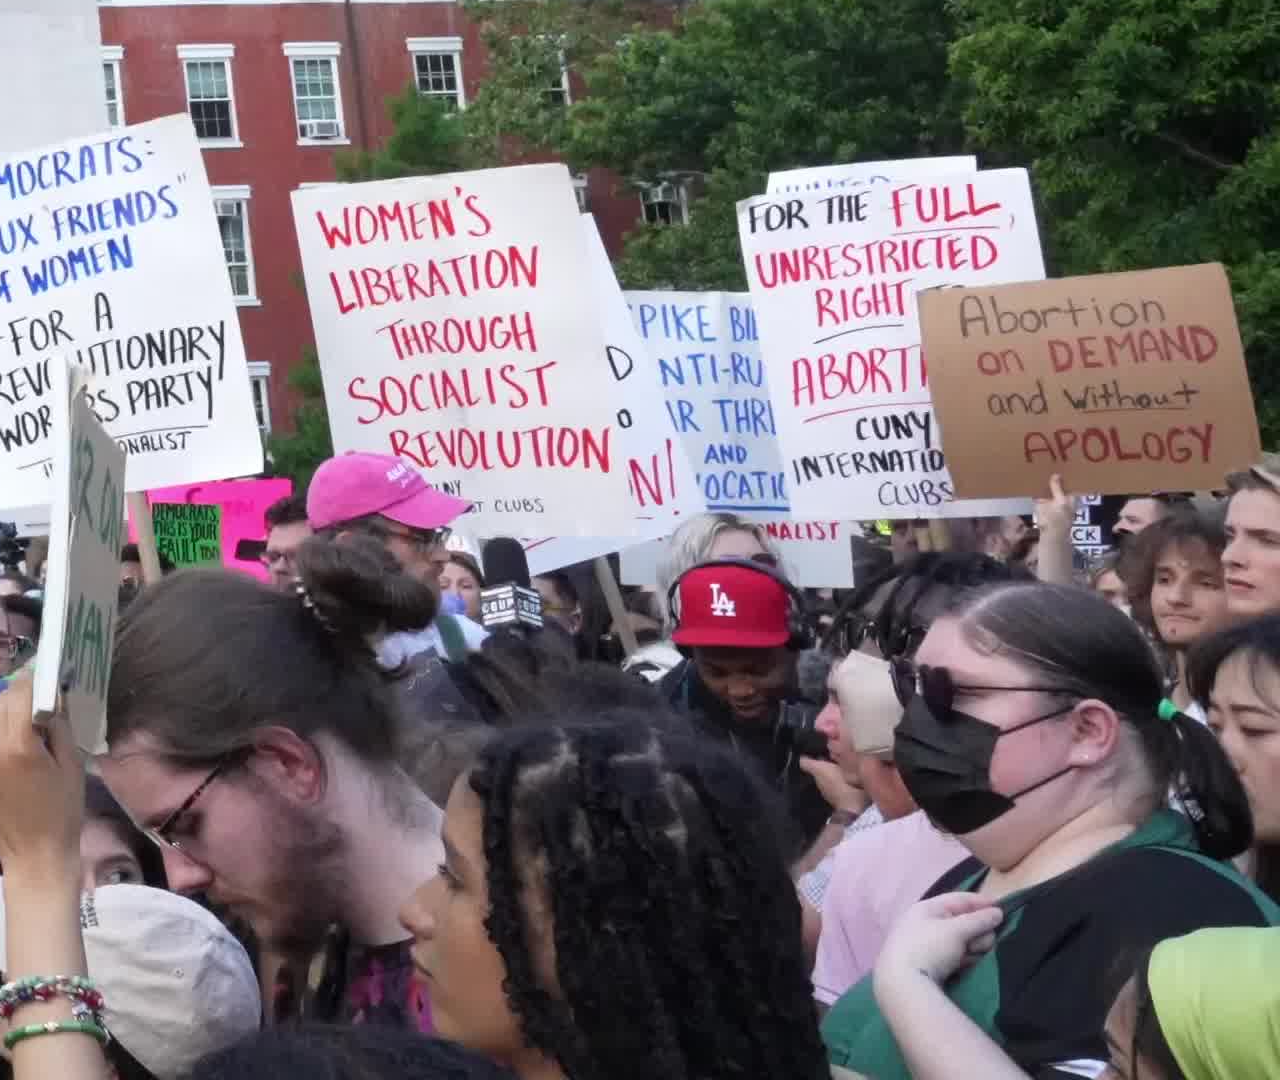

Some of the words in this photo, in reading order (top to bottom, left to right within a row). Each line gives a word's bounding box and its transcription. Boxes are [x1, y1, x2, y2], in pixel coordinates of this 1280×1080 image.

[315, 186, 492, 249] WOMEN'S
[748, 200, 810, 234] FOR
[816, 190, 874, 226] THE
[22, 233, 134, 296] WOMEN
[328, 245, 539, 314] LIBERATION
[754, 234, 998, 289] UNRESTRICTED
[94, 292, 114, 332] A
[630, 303, 718, 343] PIKE
[814, 278, 914, 328] RIGHT
[958, 294, 1167, 340] Abortion
[376, 311, 539, 361] THROUGH
[976, 347, 1026, 377] on
[1047, 323, 1220, 374] DEMAND
[126, 366, 213, 420] PARTY
[347, 361, 559, 425] SOCIALIST
[986, 379, 1049, 418] and
[389, 426, 611, 474] REVOLUTION
[855, 411, 932, 450] CUNY
[1022, 424, 1216, 464] APOLOGY
[704, 444, 748, 465] AND
[494, 498, 546, 514] CLUBS
[878, 480, 954, 507] CLUBS
[760, 521, 841, 541] NALIST
